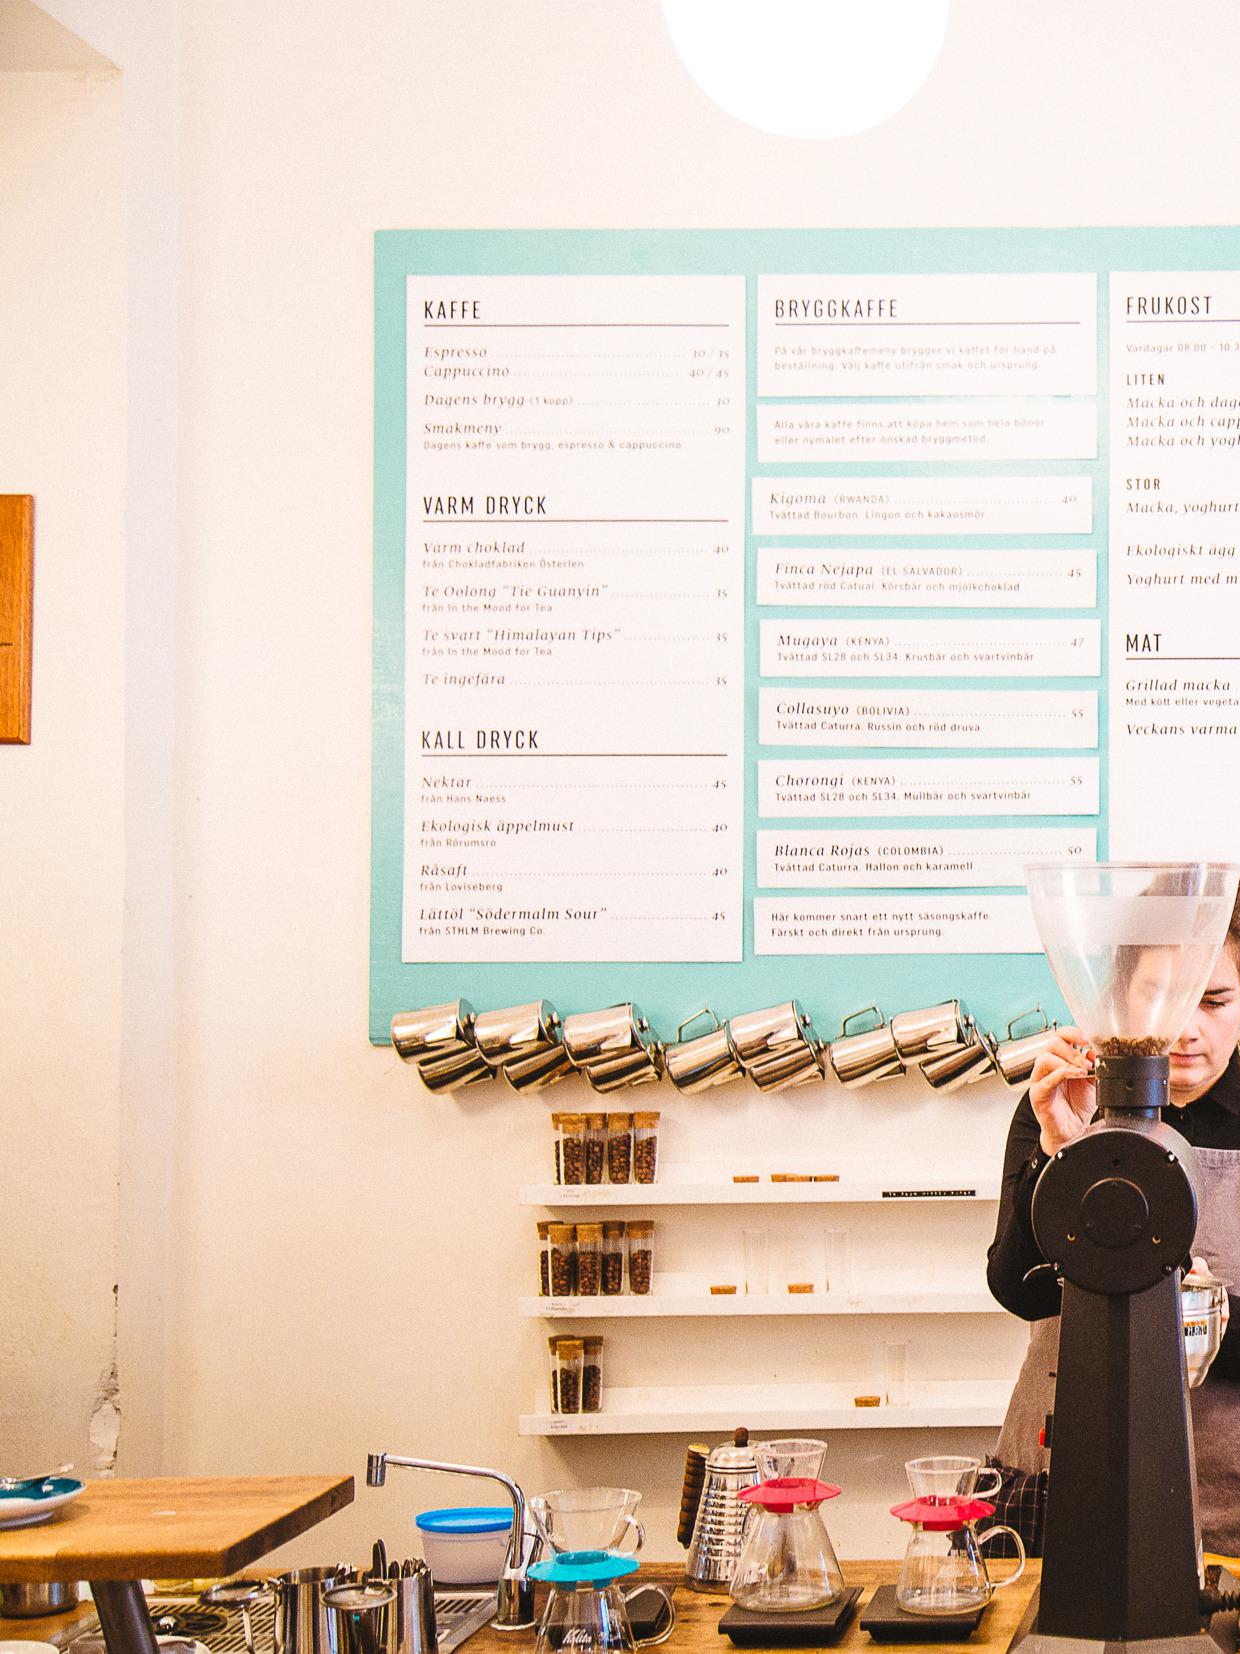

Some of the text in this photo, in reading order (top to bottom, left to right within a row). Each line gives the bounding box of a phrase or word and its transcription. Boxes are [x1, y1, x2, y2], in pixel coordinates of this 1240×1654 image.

[424, 300, 479, 319] KAFFE
[775, 299, 896, 317] BRYGGKAFFE
[1126, 296, 1211, 315] FRUKOST
[424, 346, 486, 360] Espresso
[424, 367, 509, 379] Cappuccino
[1126, 373, 1164, 385] LITEN
[424, 393, 524, 406] Dagens brygg
[1128, 396, 1174, 408] Macka
[1180, 396, 1204, 407] och
[424, 421, 501, 433] Smakmeny
[1128, 415, 1174, 427] Macka
[1180, 415, 1204, 426] och
[1128, 434, 1174, 446] Macka
[1180, 434, 1204, 446] och
[1126, 478, 1160, 490] STOR
[423, 495, 546, 514] VARM DRYCK
[770, 492, 825, 505] Kigoma
[834, 495, 889, 504] (RWANDA)
[424, 542, 461, 553] Varm
[467, 541, 524, 553] choklad
[1126, 544, 1202, 557] Ekologiskt
[1208, 546, 1235, 557] ägg
[775, 563, 814, 574] Finca
[822, 563, 872, 578] Nejapa
[903, 567, 961, 575] SALVADOR)
[1127, 572, 1184, 586] Yoghurt
[1190, 572, 1220, 584] med
[778, 635, 837, 647] Mugaya
[846, 637, 888, 645] (KENYA)
[1126, 633, 1161, 652] MAT
[424, 673, 504, 687] Te ingefära
[1125, 679, 1177, 690] Grillad
[1183, 679, 1230, 690] macka
[1125, 697, 1146, 705] Med
[1174, 697, 1198, 705] eller
[776, 702, 848, 715] Collasuyo
[856, 706, 909, 715] (BOLIVIA)
[1127, 723, 1184, 735] Veckans
[1191, 726, 1236, 734] varma
[422, 730, 538, 749] KALL DRYCK
[422, 776, 470, 788] Nektar
[775, 774, 843, 787] Chorongi
[851, 776, 895, 785] (KENYA)
[776, 792, 815, 801] Tvättad
[848, 792, 867, 800] och
[947, 791, 966, 800] och
[970, 791, 1030, 799] svartvinbär
[421, 819, 490, 832] Ekologisk
[496, 819, 573, 834] äppelmust
[774, 844, 824, 856] Blanca
[830, 844, 869, 858] Rojas
[877, 846, 943, 856] (COLOMBIA)
[420, 864, 466, 877] Råsaft
[774, 863, 814, 871] Tvättad
[865, 862, 898, 871] Hallon
[902, 862, 922, 870] och
[926, 861, 972, 870] karamell
[420, 908, 463, 920] Lättöl
[771, 913, 788, 921] Här
[793, 912, 835, 920] kommer
[872, 912, 886, 920] ett
[892, 912, 912, 922] nytt
[419, 926, 440, 934] från
[445, 926, 478, 935] STHLM
[483, 926, 525, 936] Brewing
[771, 928, 803, 936] Färskt
[808, 928, 827, 936] och
[831, 927, 862, 936] direkt
[868, 927, 889, 936] från
